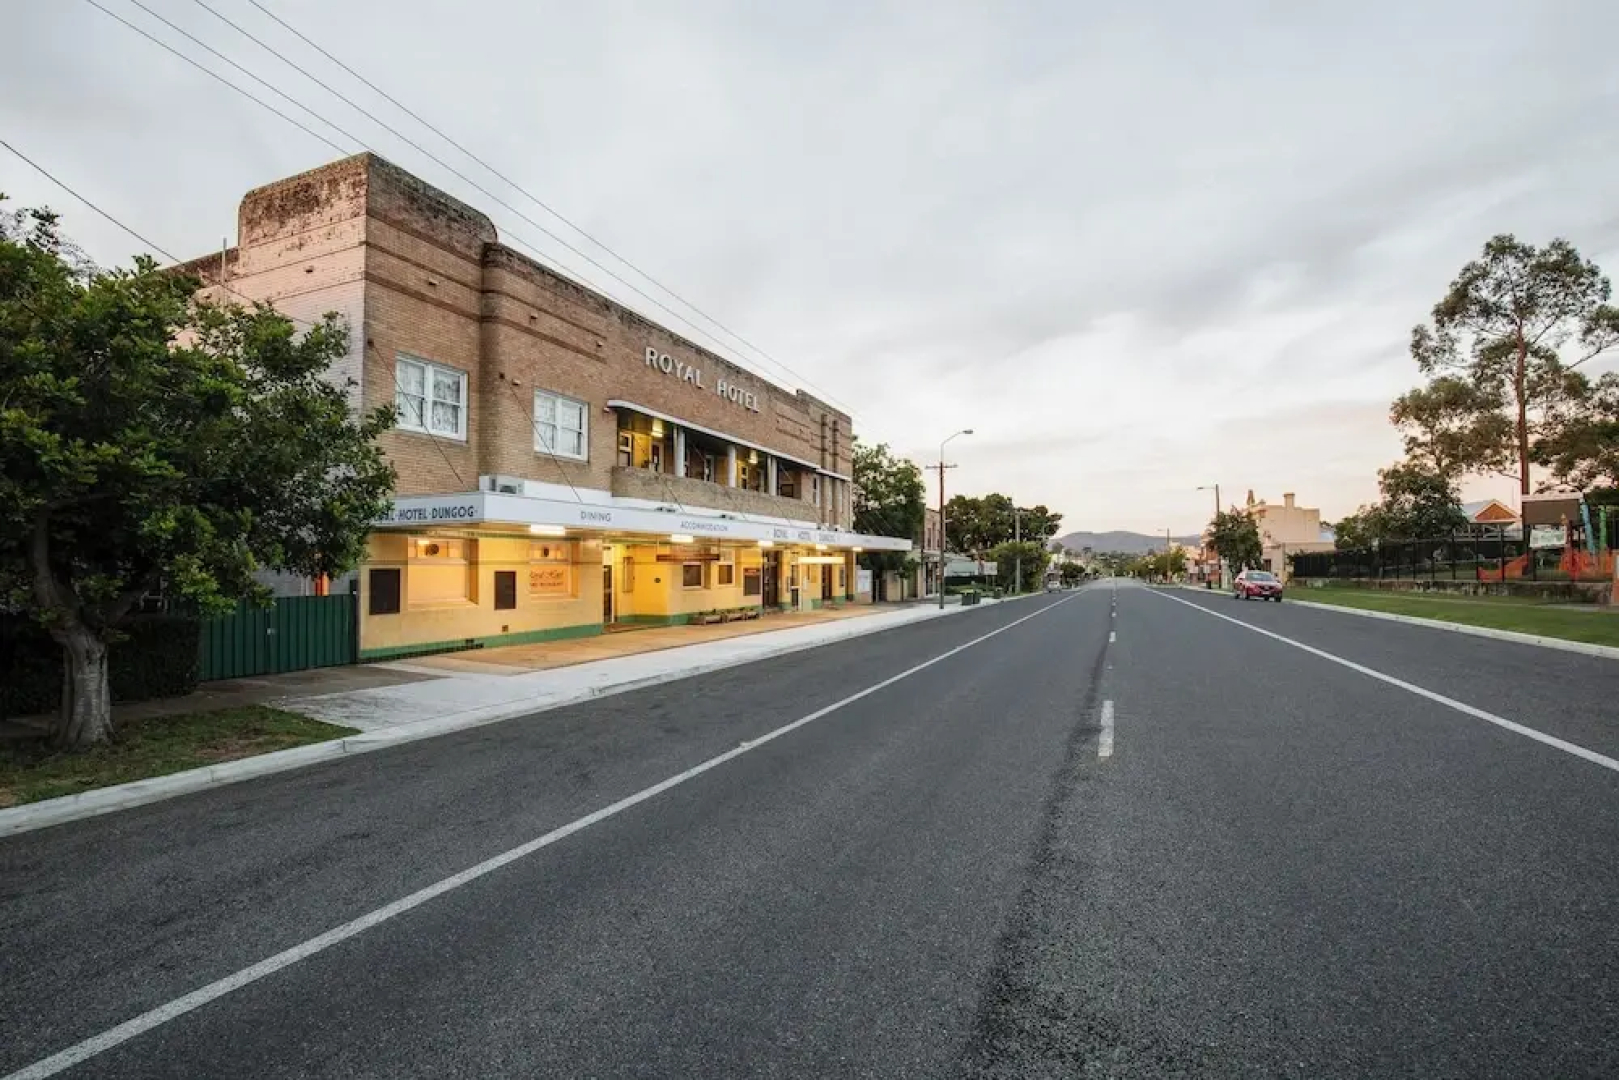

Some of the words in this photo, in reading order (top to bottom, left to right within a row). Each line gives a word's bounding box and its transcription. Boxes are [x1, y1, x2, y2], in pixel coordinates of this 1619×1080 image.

[645, 346, 705, 389] ROYAL
[716, 378, 759, 414] HOTEL
[398, 507, 428, 521] HOTEL
[431, 505, 475, 519] DUNGOG
[580, 511, 611, 522] DINING
